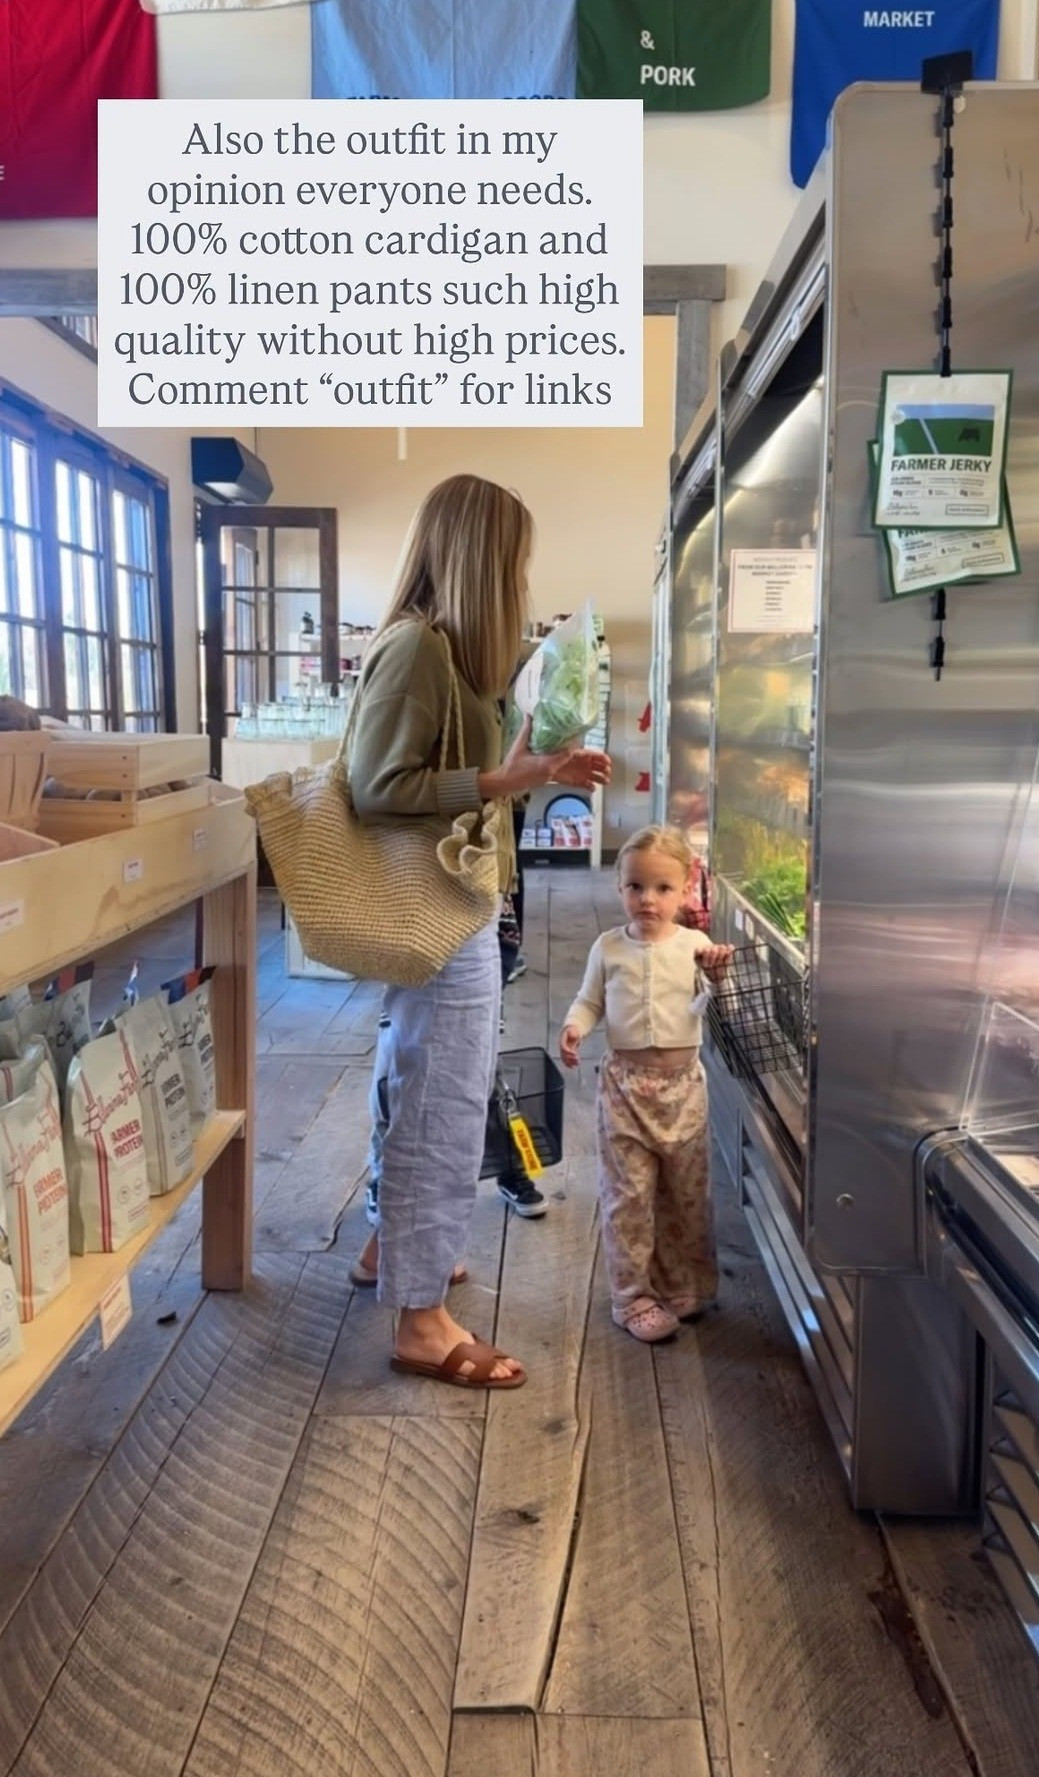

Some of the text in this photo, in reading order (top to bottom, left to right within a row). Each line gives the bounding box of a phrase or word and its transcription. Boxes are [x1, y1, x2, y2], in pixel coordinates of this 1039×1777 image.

[863, 11, 935, 28] MARKET
[640, 30, 655, 50] &
[640, 64, 696, 87] PORK
[891, 458, 992, 473] FARMER JERKY
